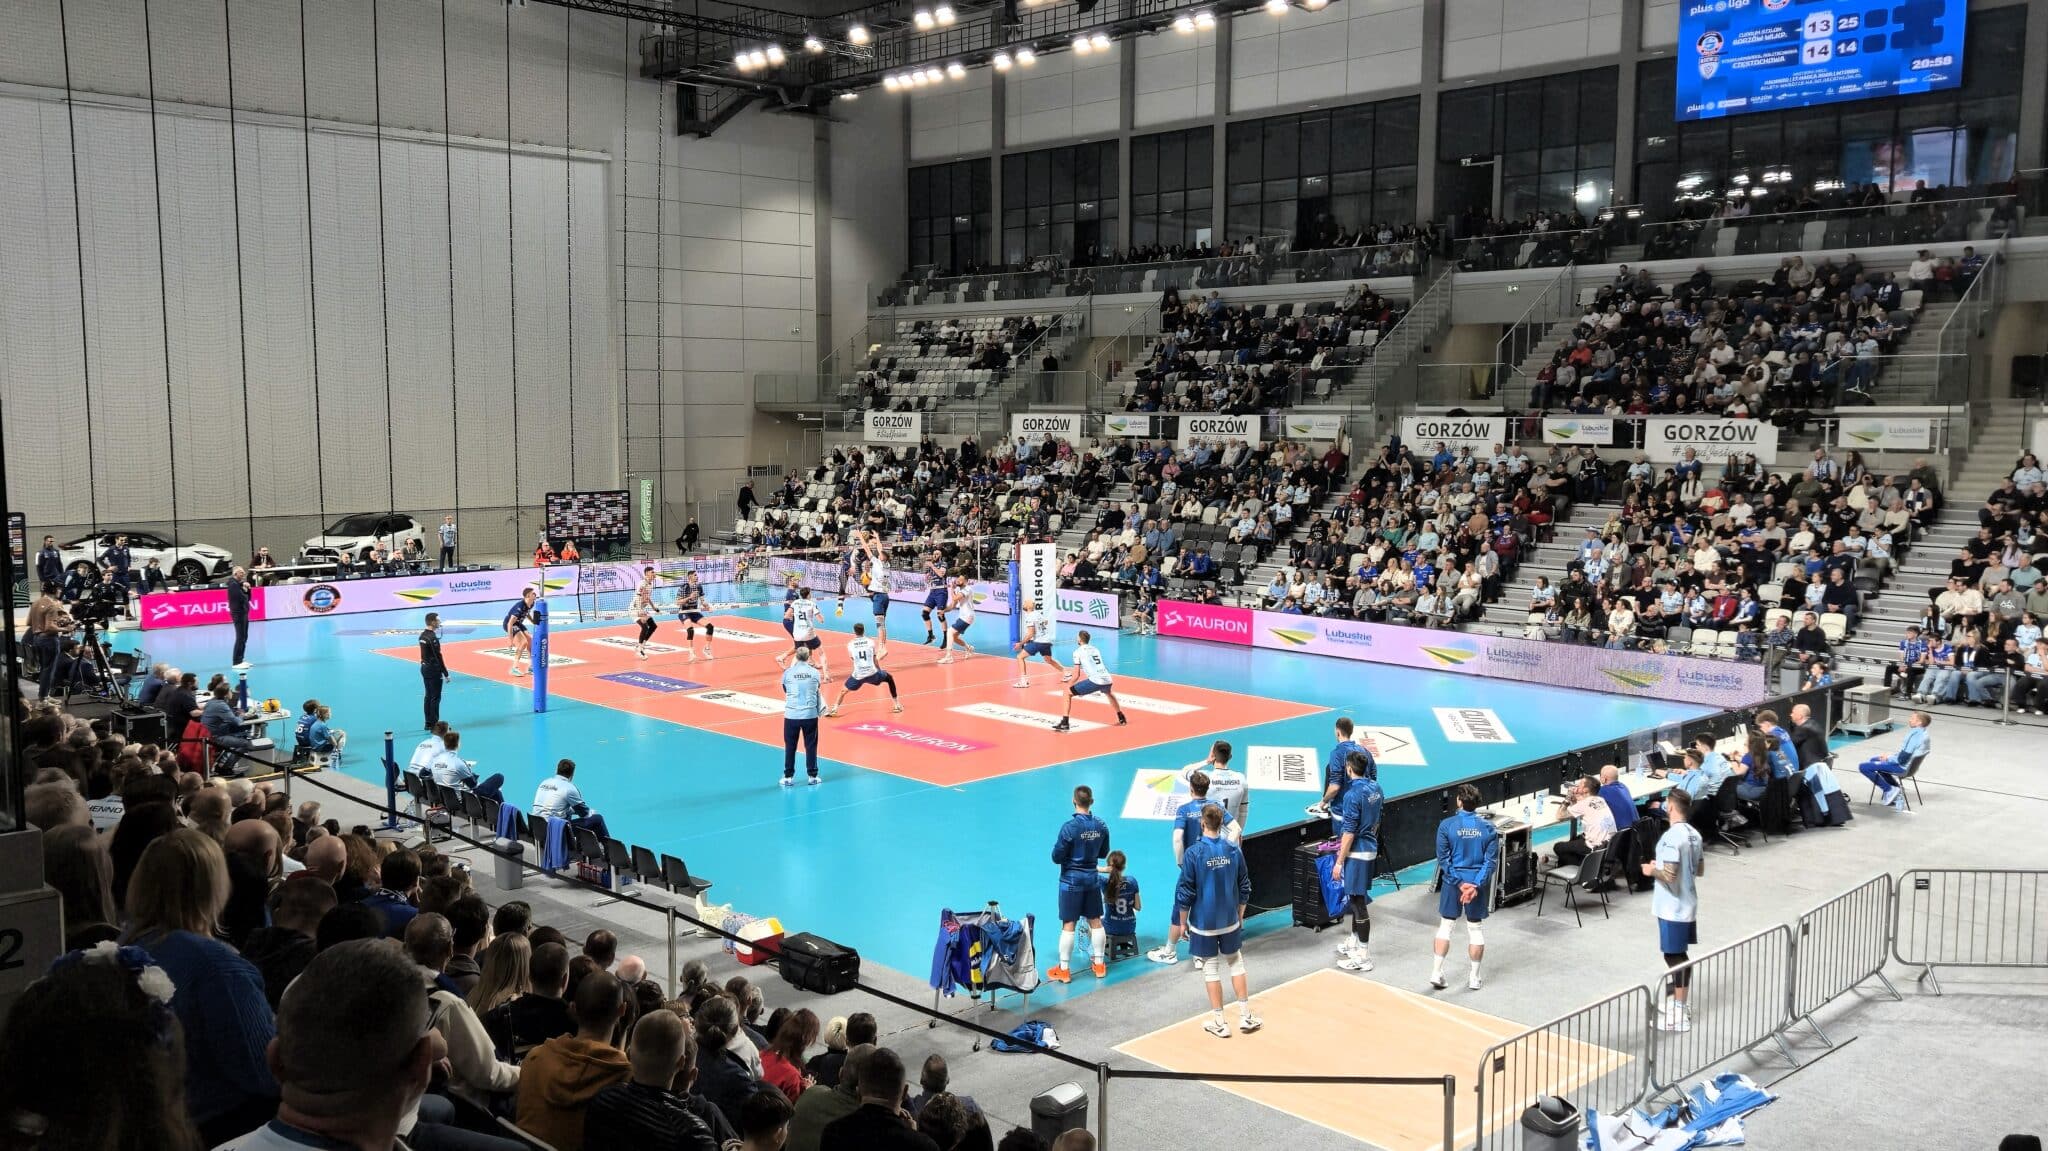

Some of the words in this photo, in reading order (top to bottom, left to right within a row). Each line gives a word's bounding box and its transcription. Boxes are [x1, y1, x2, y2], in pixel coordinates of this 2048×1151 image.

[1690, 4, 1713, 16] plus
[1808, 19, 1831, 33] 13
[1838, 16, 1859, 30] 25
[1807, 44, 1830, 58] 14
[1837, 41, 1857, 54] 14
[1911, 55, 1954, 70] 20:58
[872, 415, 913, 428] GORZÓW
[1022, 416, 1071, 431] GORZÓW
[1189, 417, 1248, 433] GORZÓW
[1416, 419, 1490, 438] GORZÓW
[1664, 421, 1758, 441] GORZÓW
[449, 578, 492, 589] Lubuskie
[180, 600, 259, 616] TAURN
[1056, 594, 1084, 613] lus
[799, 611, 807, 620] 21
[1186, 615, 1248, 634] TAURON
[1325, 627, 1373, 642] Lubuskie
[858, 650, 867, 661] 4
[1092, 655, 1101, 665] 5
[1486, 646, 1542, 662] Lubuskie
[1677, 668, 1743, 685] Lubuskie
[886, 729, 976, 752] TAURON
[1282, 753, 1312, 783] GORZÓW
[1206, 858, 1231, 867] STILON
[1114, 898, 1128, 915] 8
